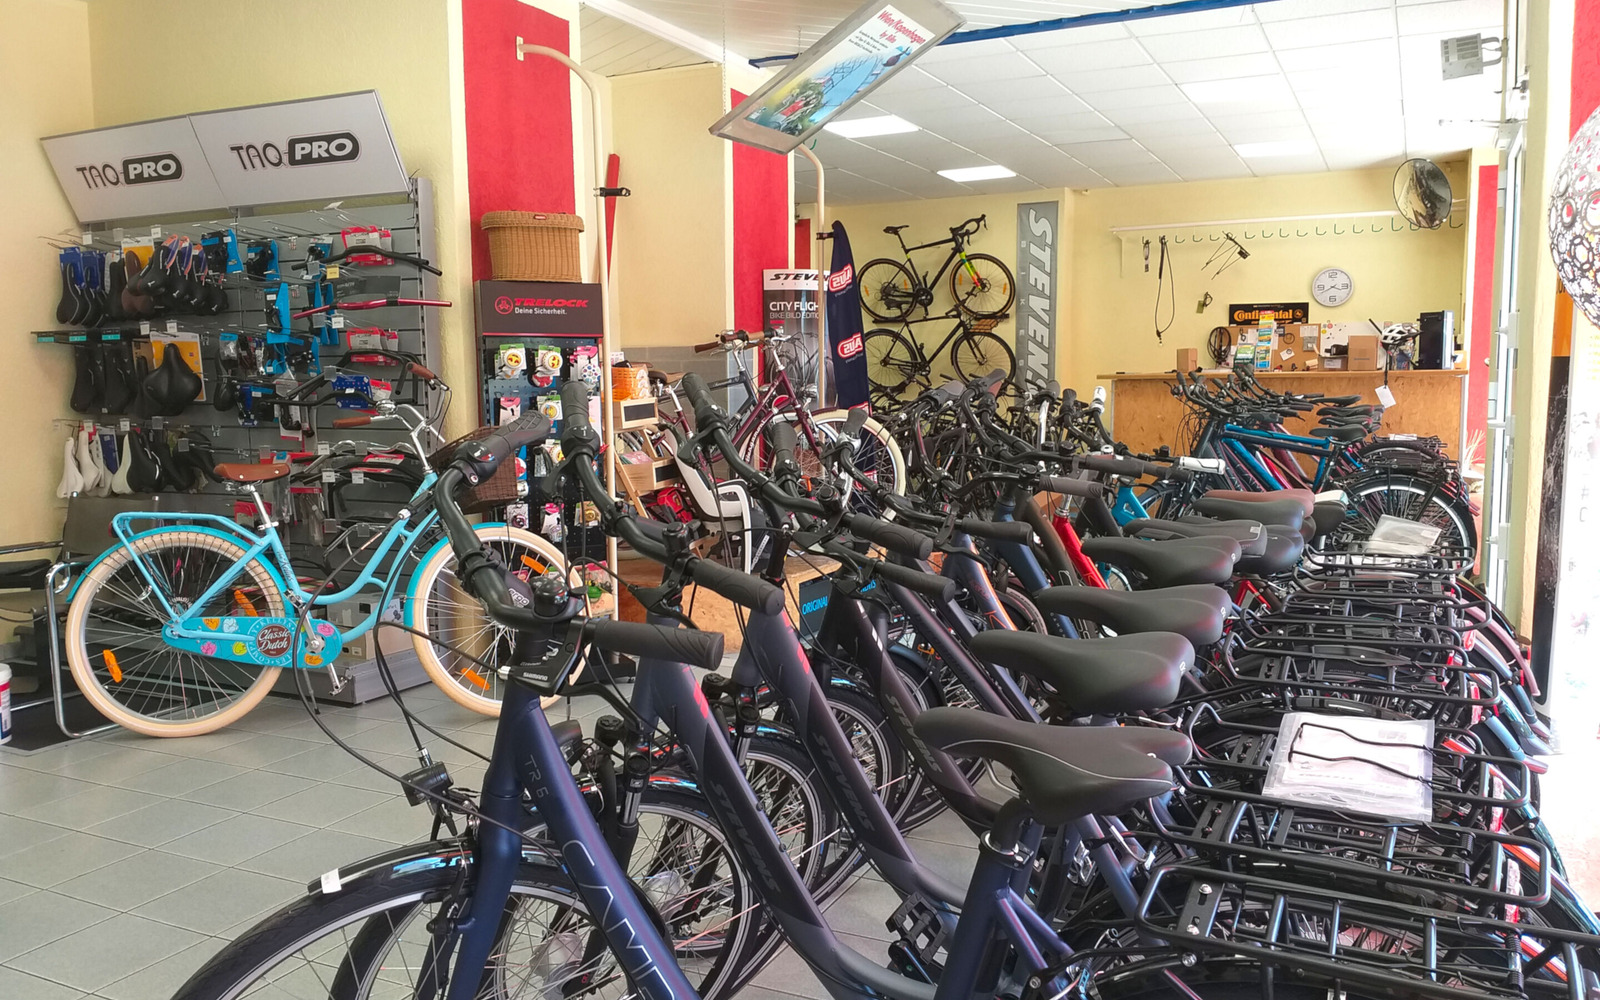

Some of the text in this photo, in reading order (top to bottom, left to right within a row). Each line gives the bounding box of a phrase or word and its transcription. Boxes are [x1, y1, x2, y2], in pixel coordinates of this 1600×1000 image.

[295, 138, 353, 160] PRO
[128, 158, 177, 180] PRO
[1328, 271, 1338, 279] 12
[514, 298, 588, 308] TRELOCK
[1026, 208, 1053, 396] STEVENS
[1328, 295, 1337, 303] 6
[769, 301, 819, 311] CITY FLIGH
[1233, 309, 1293, 322] Contintal
[258, 628, 290, 641] Classic
[257, 637, 288, 651] Dutch
[523, 671, 549, 681] SHIMANO
[524, 753, 542, 782] TR
[708, 780, 782, 894] STEVENS
